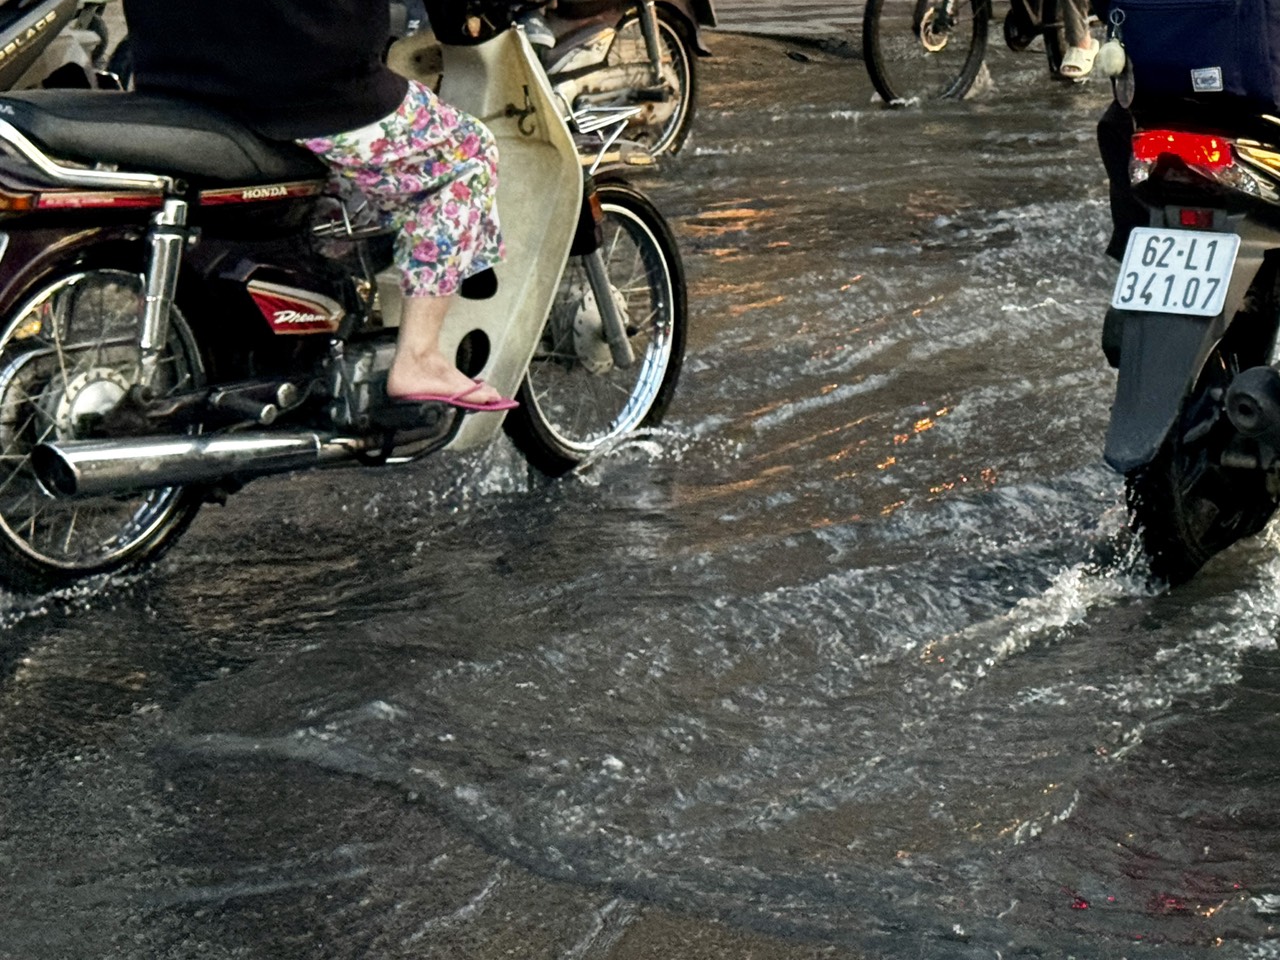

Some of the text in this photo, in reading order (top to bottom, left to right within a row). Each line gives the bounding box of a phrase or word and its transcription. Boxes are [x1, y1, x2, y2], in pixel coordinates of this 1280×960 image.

[242, 186, 288, 200] HONDA
[1120, 271, 1221, 310] 341.07
[273, 309, 326, 324] Dream
